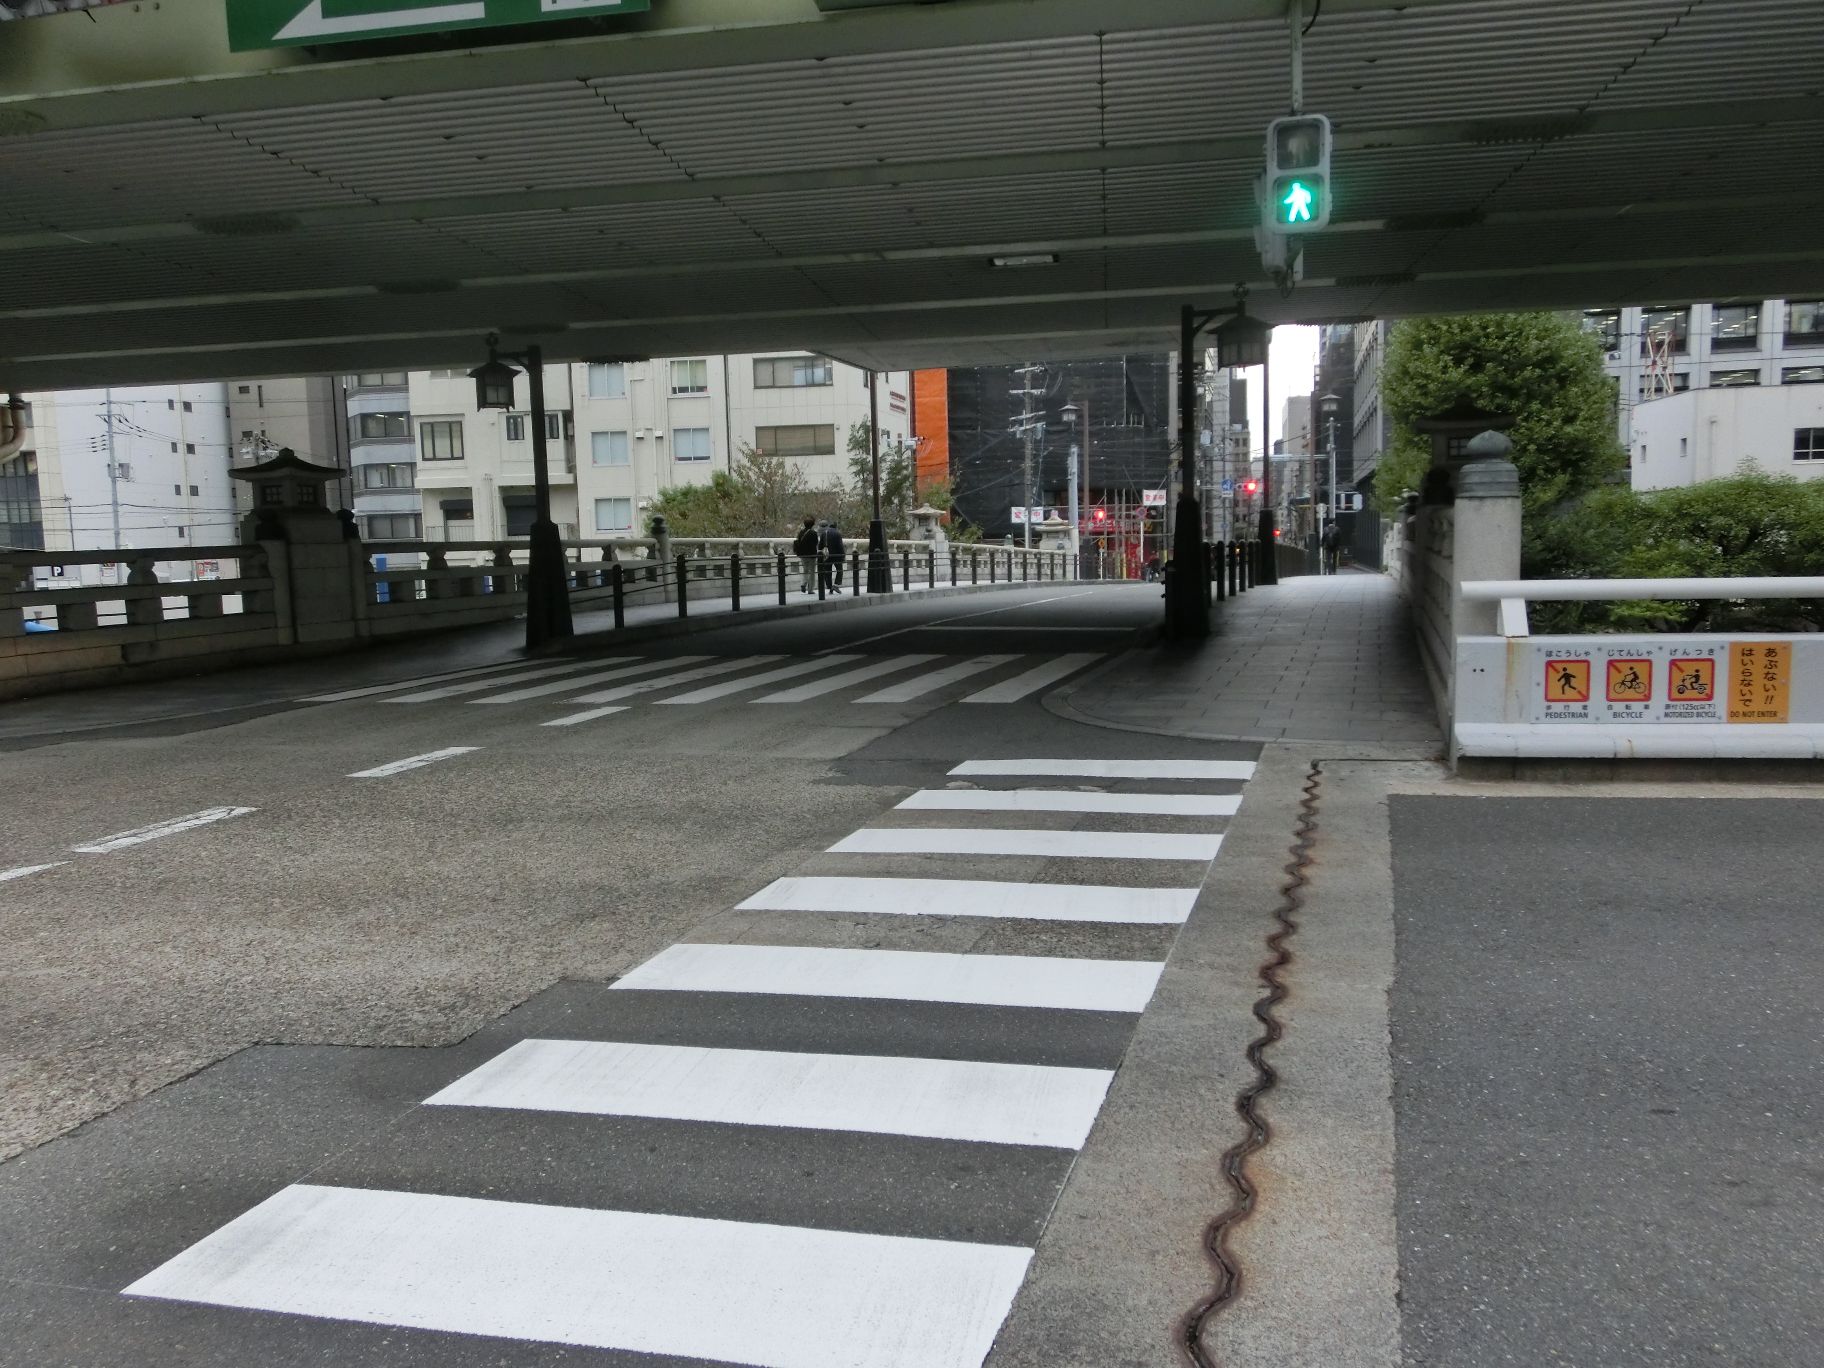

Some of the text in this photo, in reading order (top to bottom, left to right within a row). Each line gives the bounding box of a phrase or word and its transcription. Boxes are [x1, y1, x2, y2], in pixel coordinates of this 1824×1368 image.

[53, 566, 61, 576] P
[1545, 649, 1591, 658] ほこうしゃ
[1607, 649, 1653, 657] じてんしゃ
[1669, 648, 1715, 656] げんつき
[1739, 647, 1756, 707] はいらないで
[1545, 711, 1589, 719] PEDESTRIAN
[1612, 711, 1644, 719] BICYCLE
[1664, 711, 1717, 719] MOTORIZED BICYCLE
